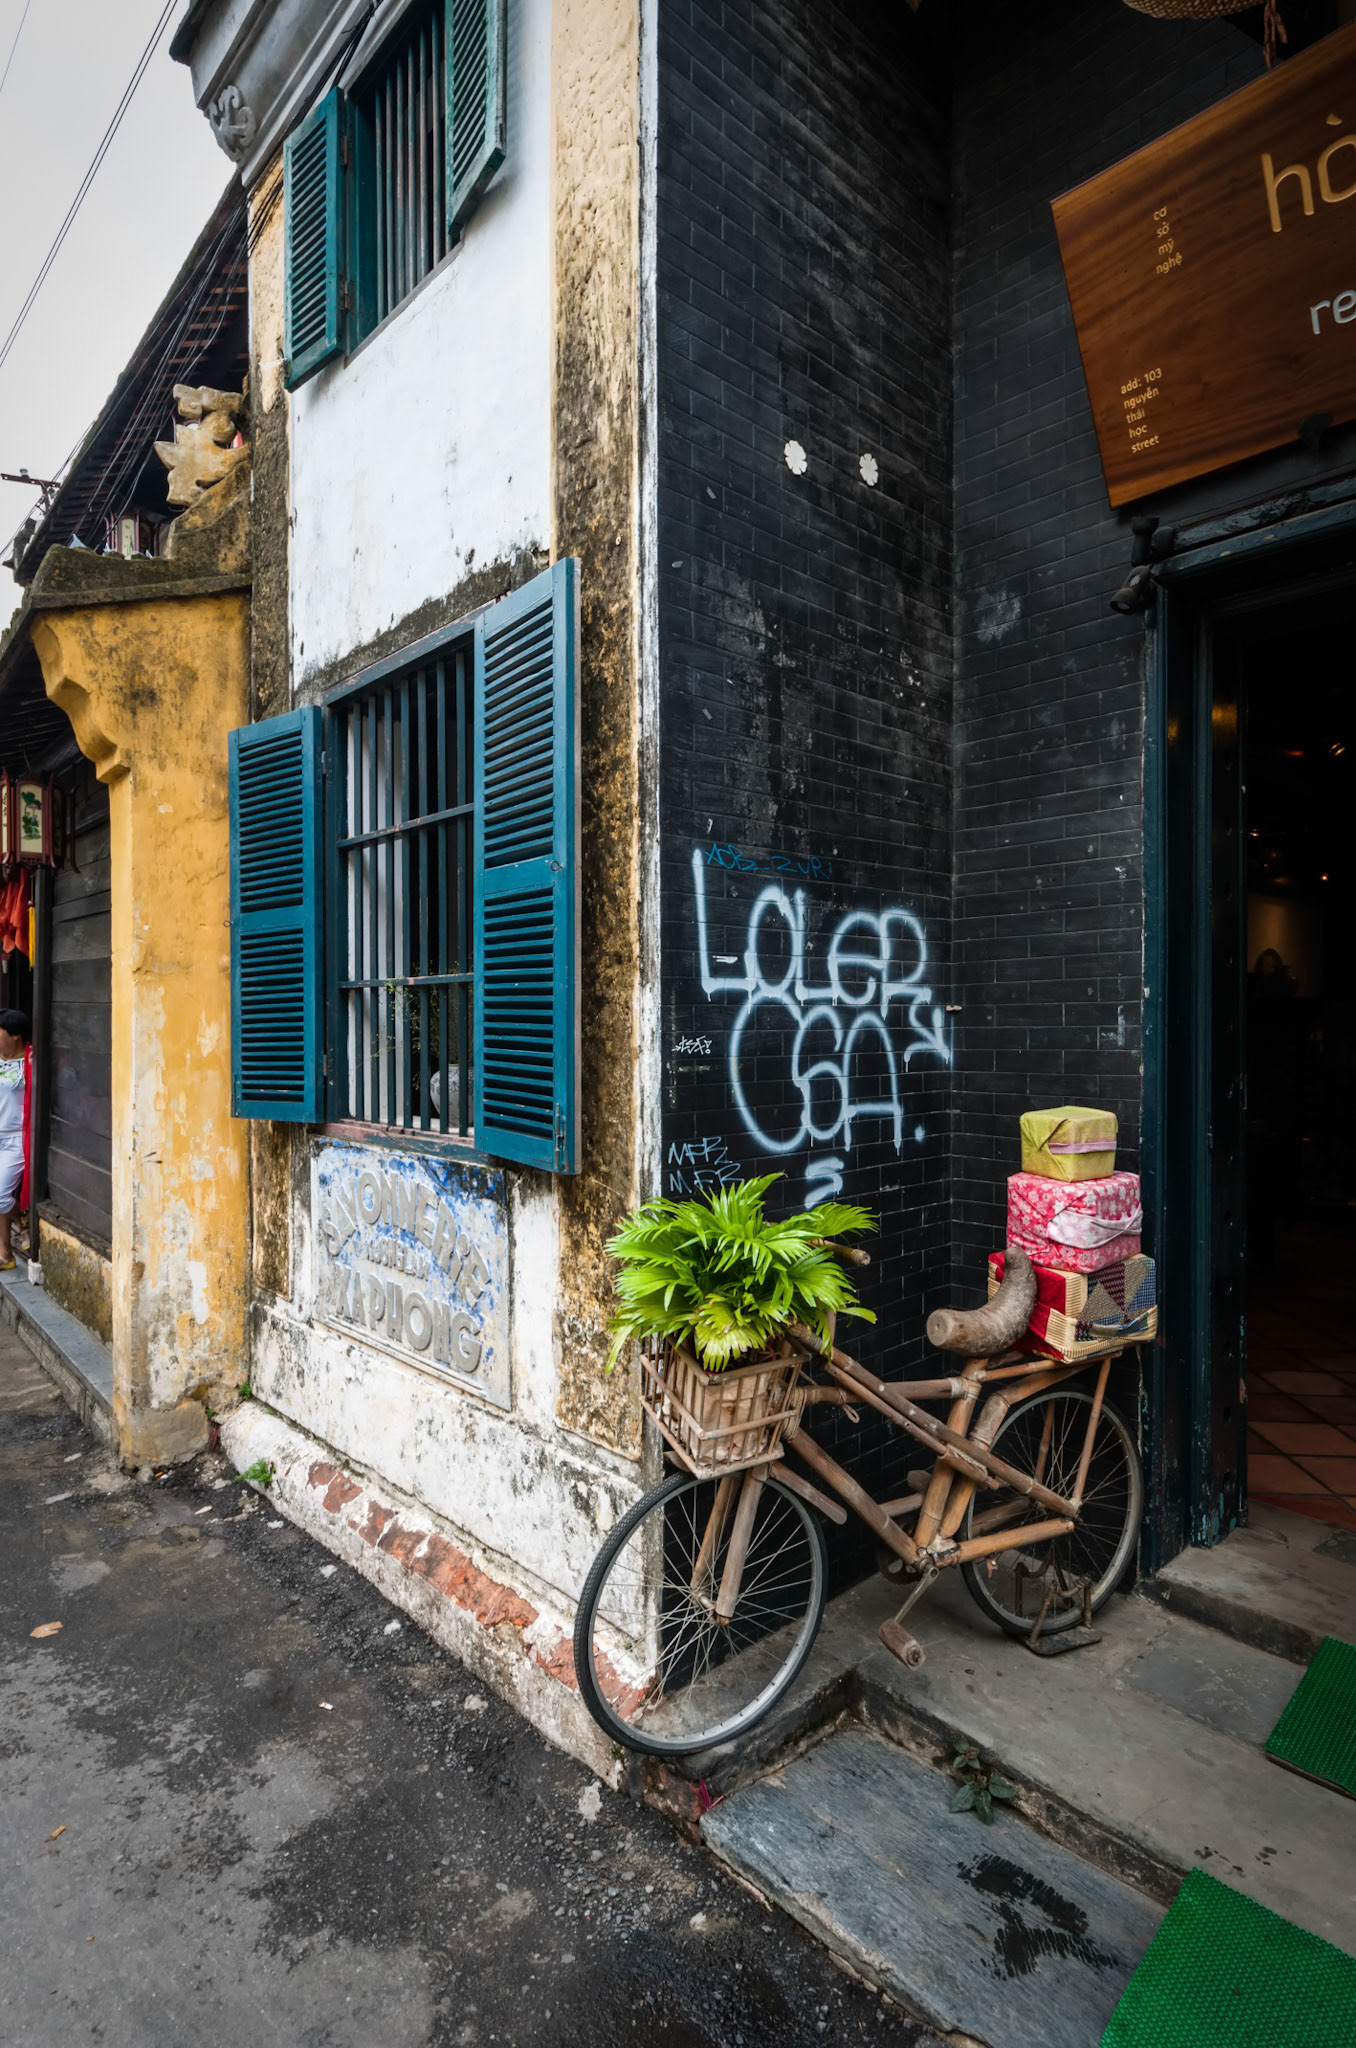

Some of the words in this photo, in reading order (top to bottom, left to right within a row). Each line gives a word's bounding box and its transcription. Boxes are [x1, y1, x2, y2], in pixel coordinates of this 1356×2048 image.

[1120, 377, 1142, 395] add:
[1144, 367, 1162, 384] 103
[1126, 408, 1146, 424] thái
[1129, 424, 1148, 439] học
[1131, 435, 1160, 454] street
